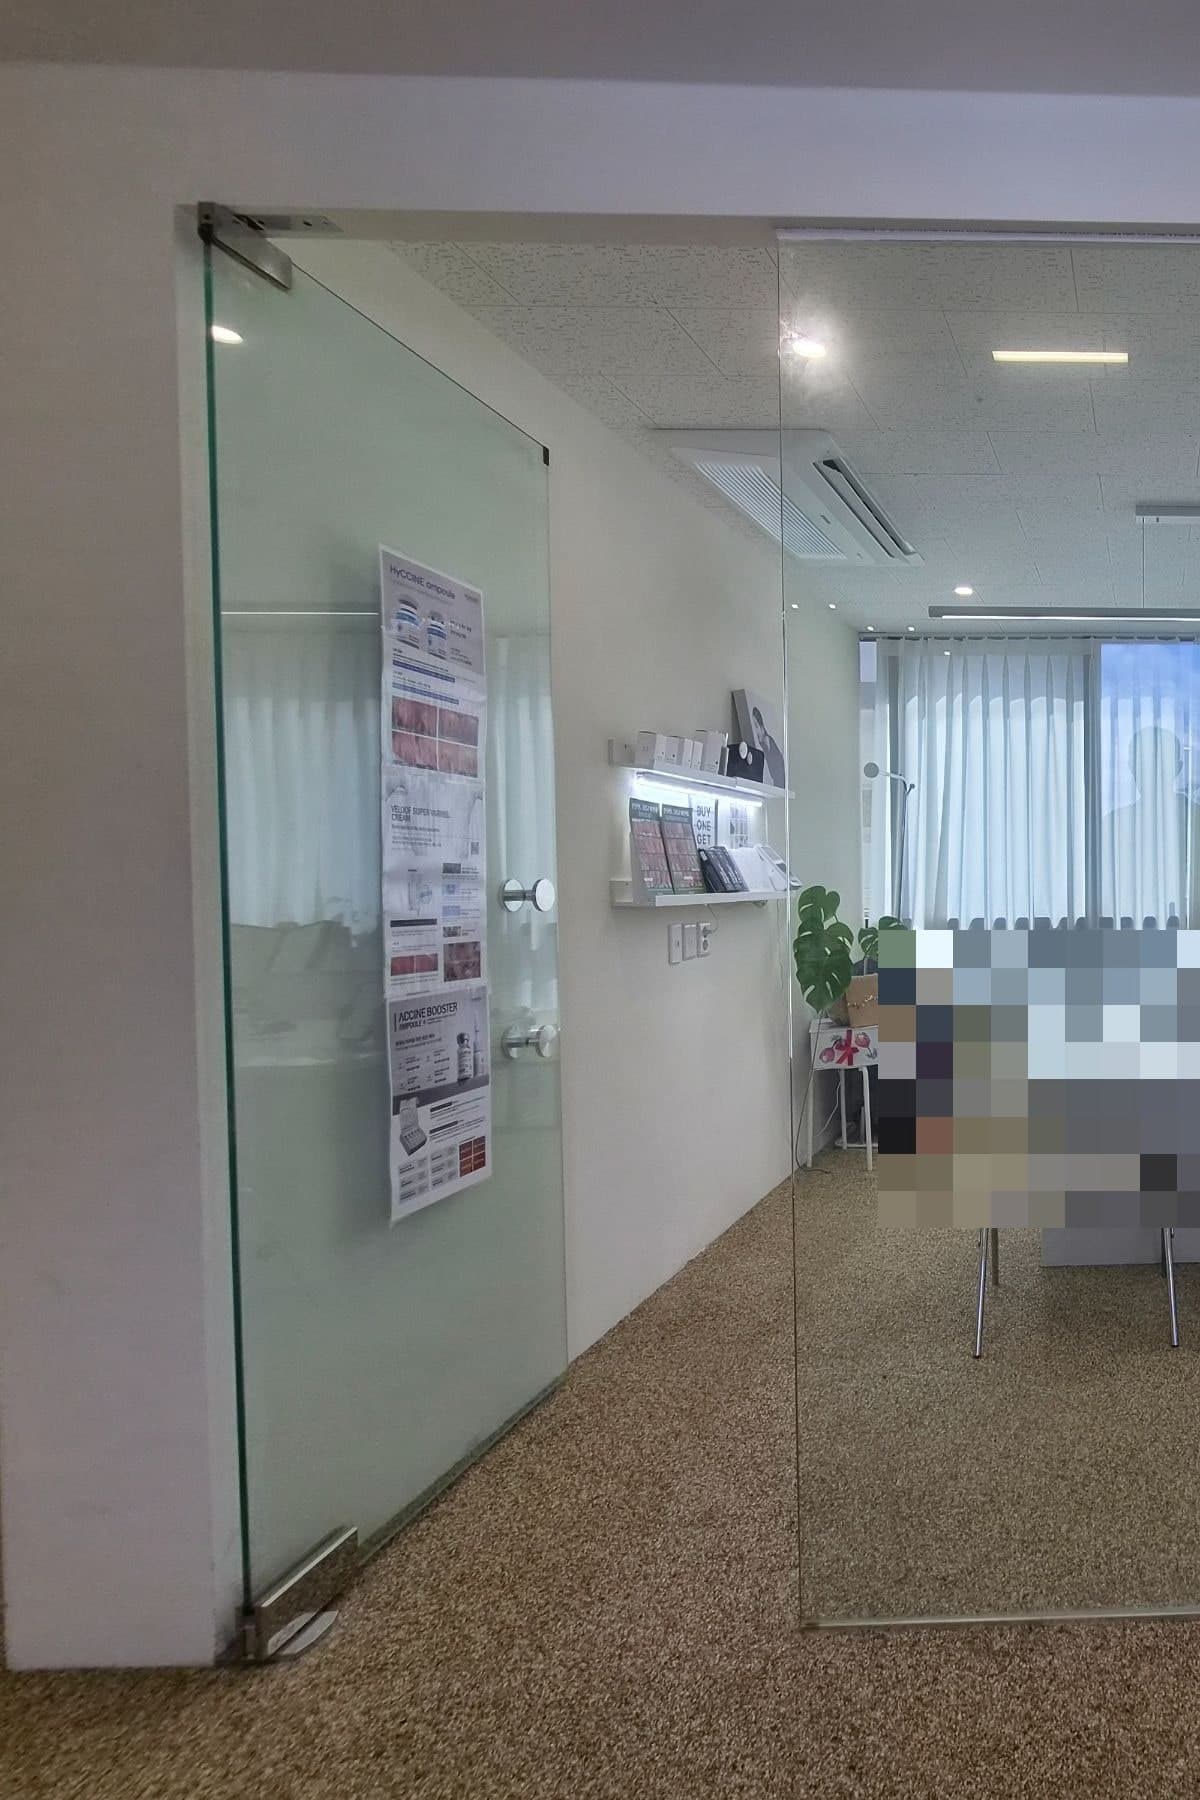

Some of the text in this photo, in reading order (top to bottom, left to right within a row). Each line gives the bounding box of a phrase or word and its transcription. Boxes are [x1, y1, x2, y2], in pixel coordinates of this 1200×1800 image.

[697, 805, 711, 817] BUY
[697, 819, 711, 832] ONE
[697, 834, 711, 845] GET
[426, 1001, 458, 1018] BOOSTER
